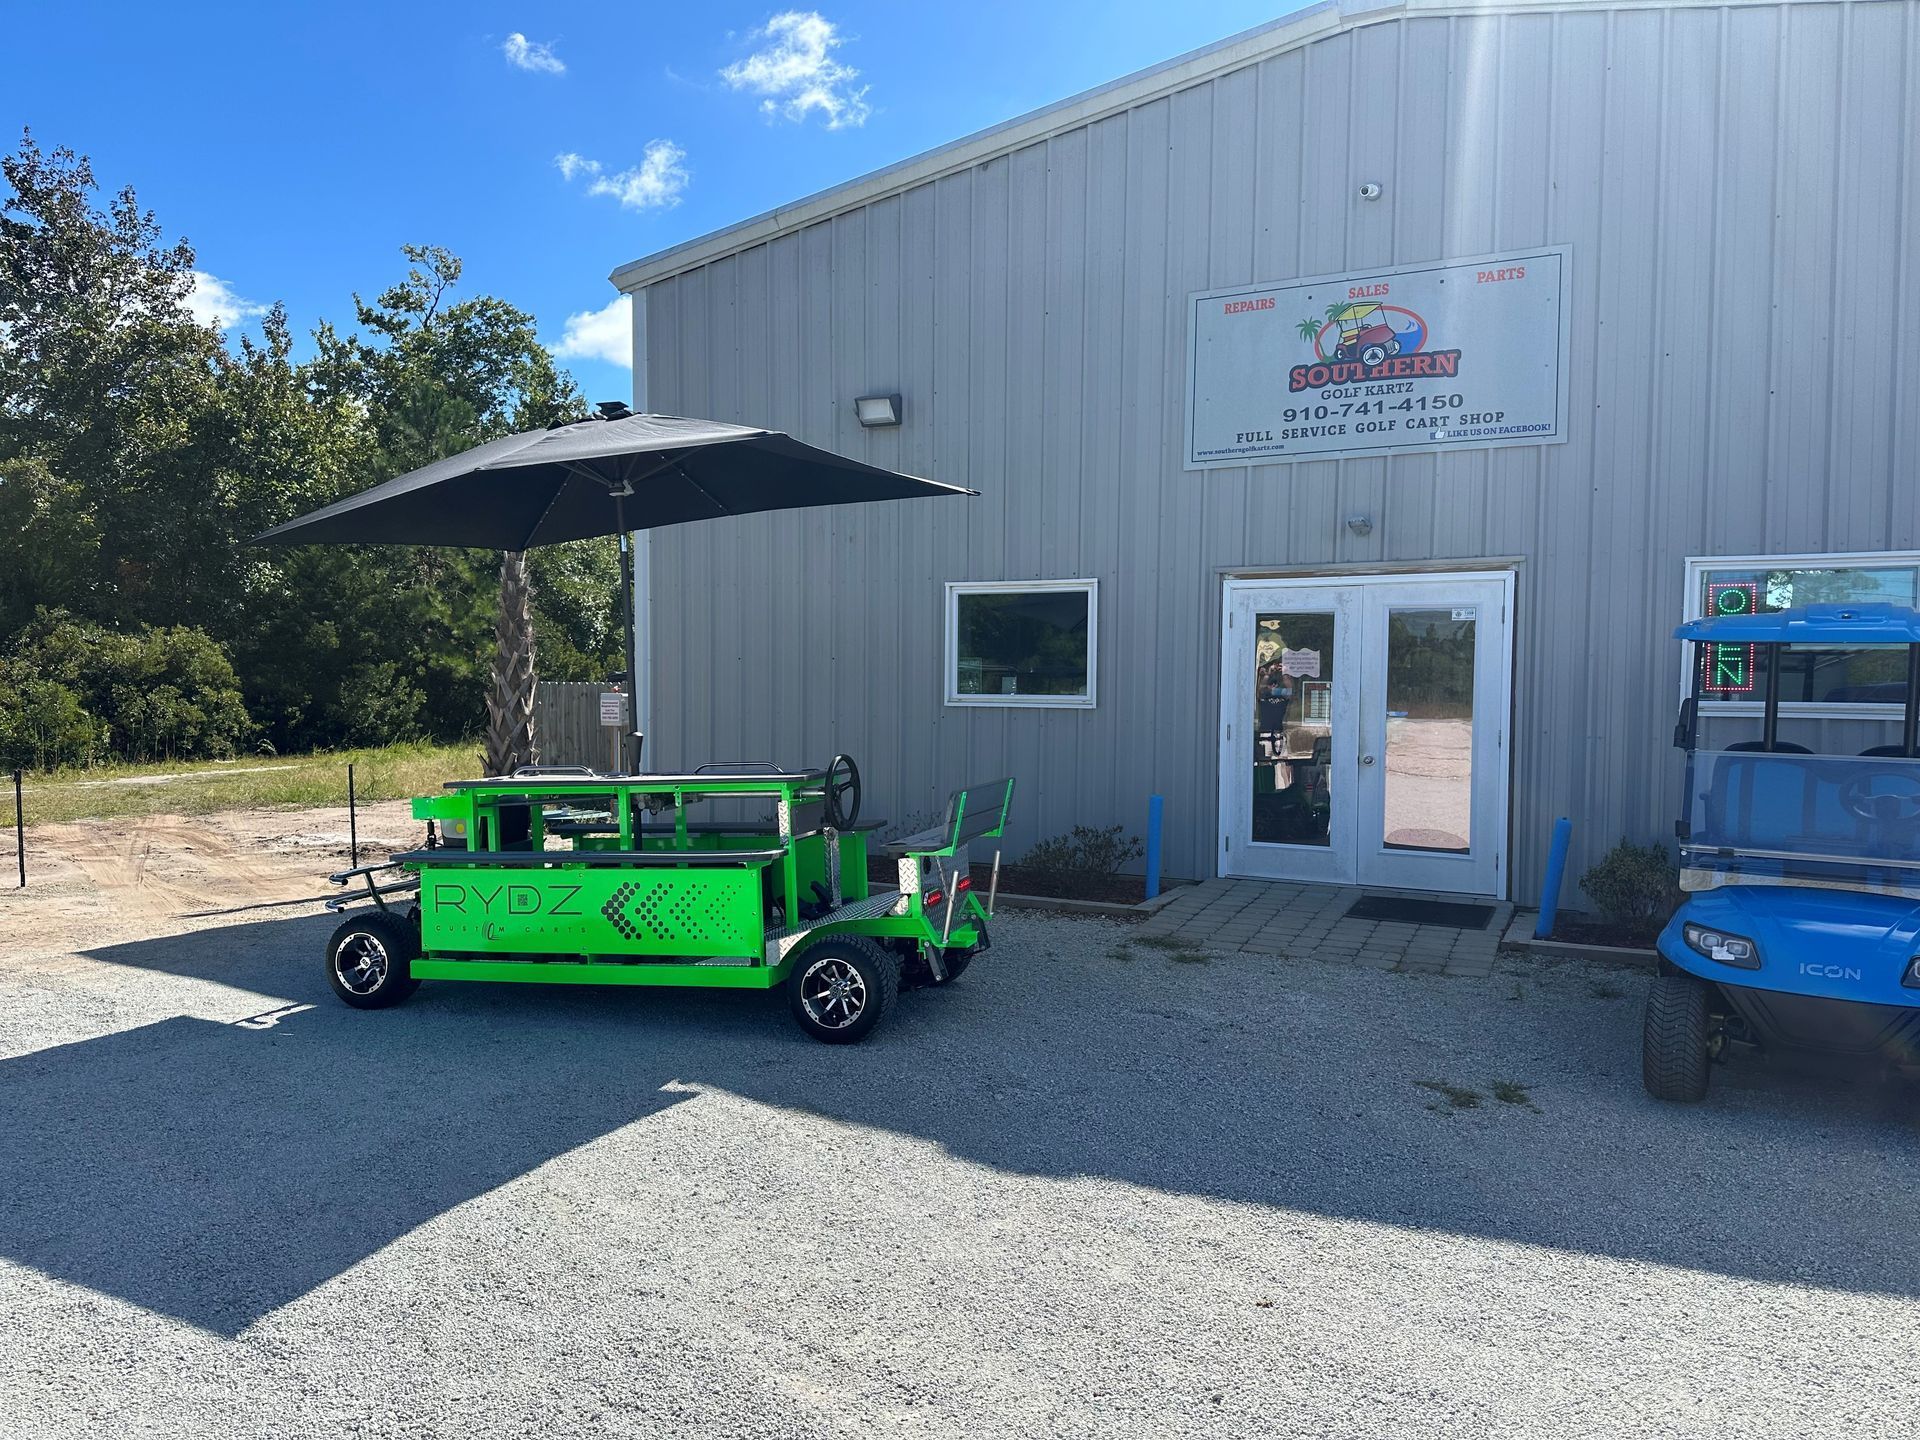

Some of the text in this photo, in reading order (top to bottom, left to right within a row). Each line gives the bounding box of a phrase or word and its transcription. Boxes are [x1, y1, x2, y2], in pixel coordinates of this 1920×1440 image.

[1476, 267, 1526, 284] PARTS
[1348, 283, 1390, 299] SALES
[1224, 297, 1276, 315] REPAIRS
[1291, 353, 1459, 390] SOUTHERN
[1321, 382, 1414, 400] GOLF KARTZ
[1282, 393, 1464, 423] 910-741-4150
[1236, 411, 1505, 444] FULL SERVICE GOLF CART SHOP
[1447, 423, 1551, 438] LIKE US ON FACEBOOK!
[1197, 443, 1285, 457] www.southerngolfkartz.com
[1716, 589, 1747, 686] OEN
[434, 884, 584, 915] RYDZ
[525, 926, 586, 934] CARTS
[1799, 962, 1862, 981] ICON
